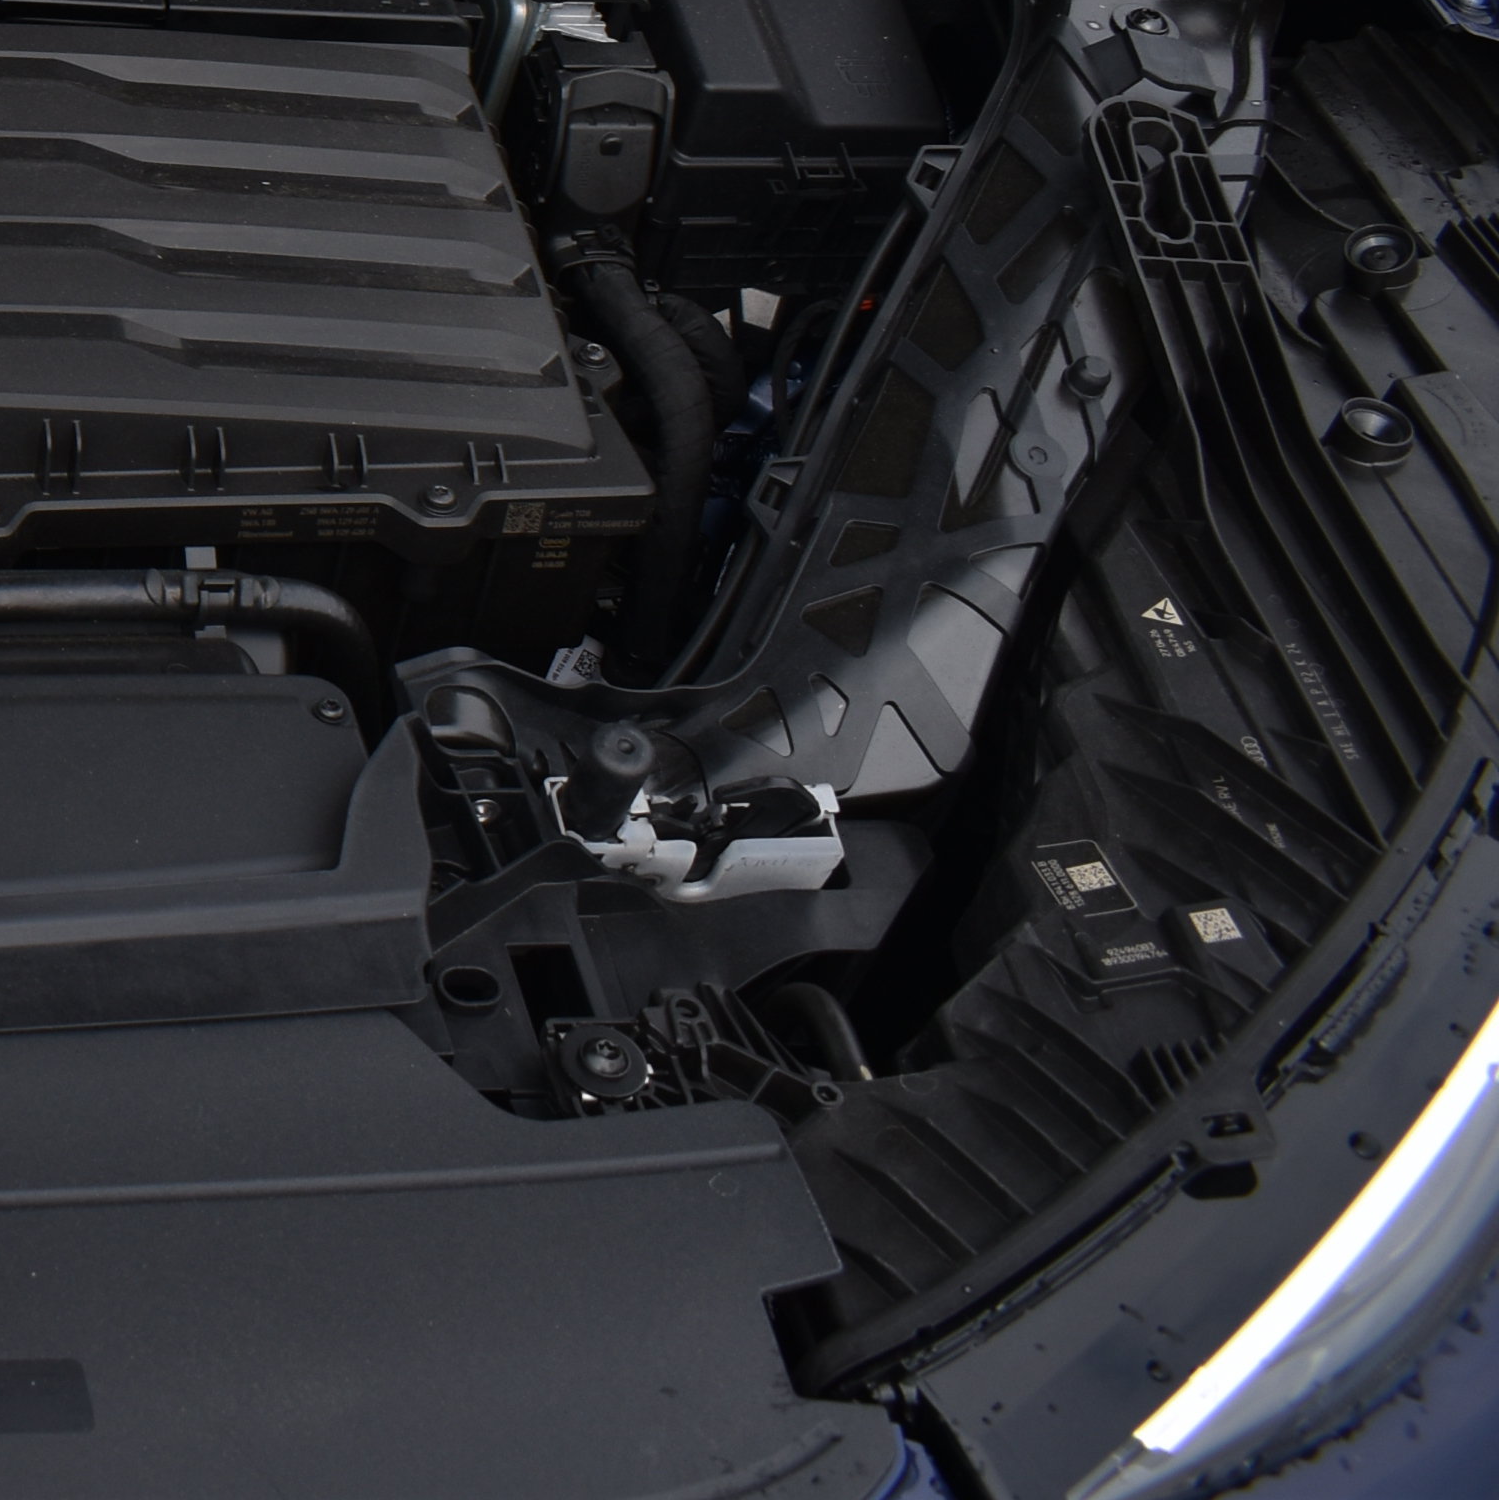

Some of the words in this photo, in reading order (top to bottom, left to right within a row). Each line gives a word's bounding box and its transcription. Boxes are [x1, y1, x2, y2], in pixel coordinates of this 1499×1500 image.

[1299, 671, 1317, 683] P2
[1309, 687, 1324, 695] P
[1338, 742, 1360, 760] SAE
